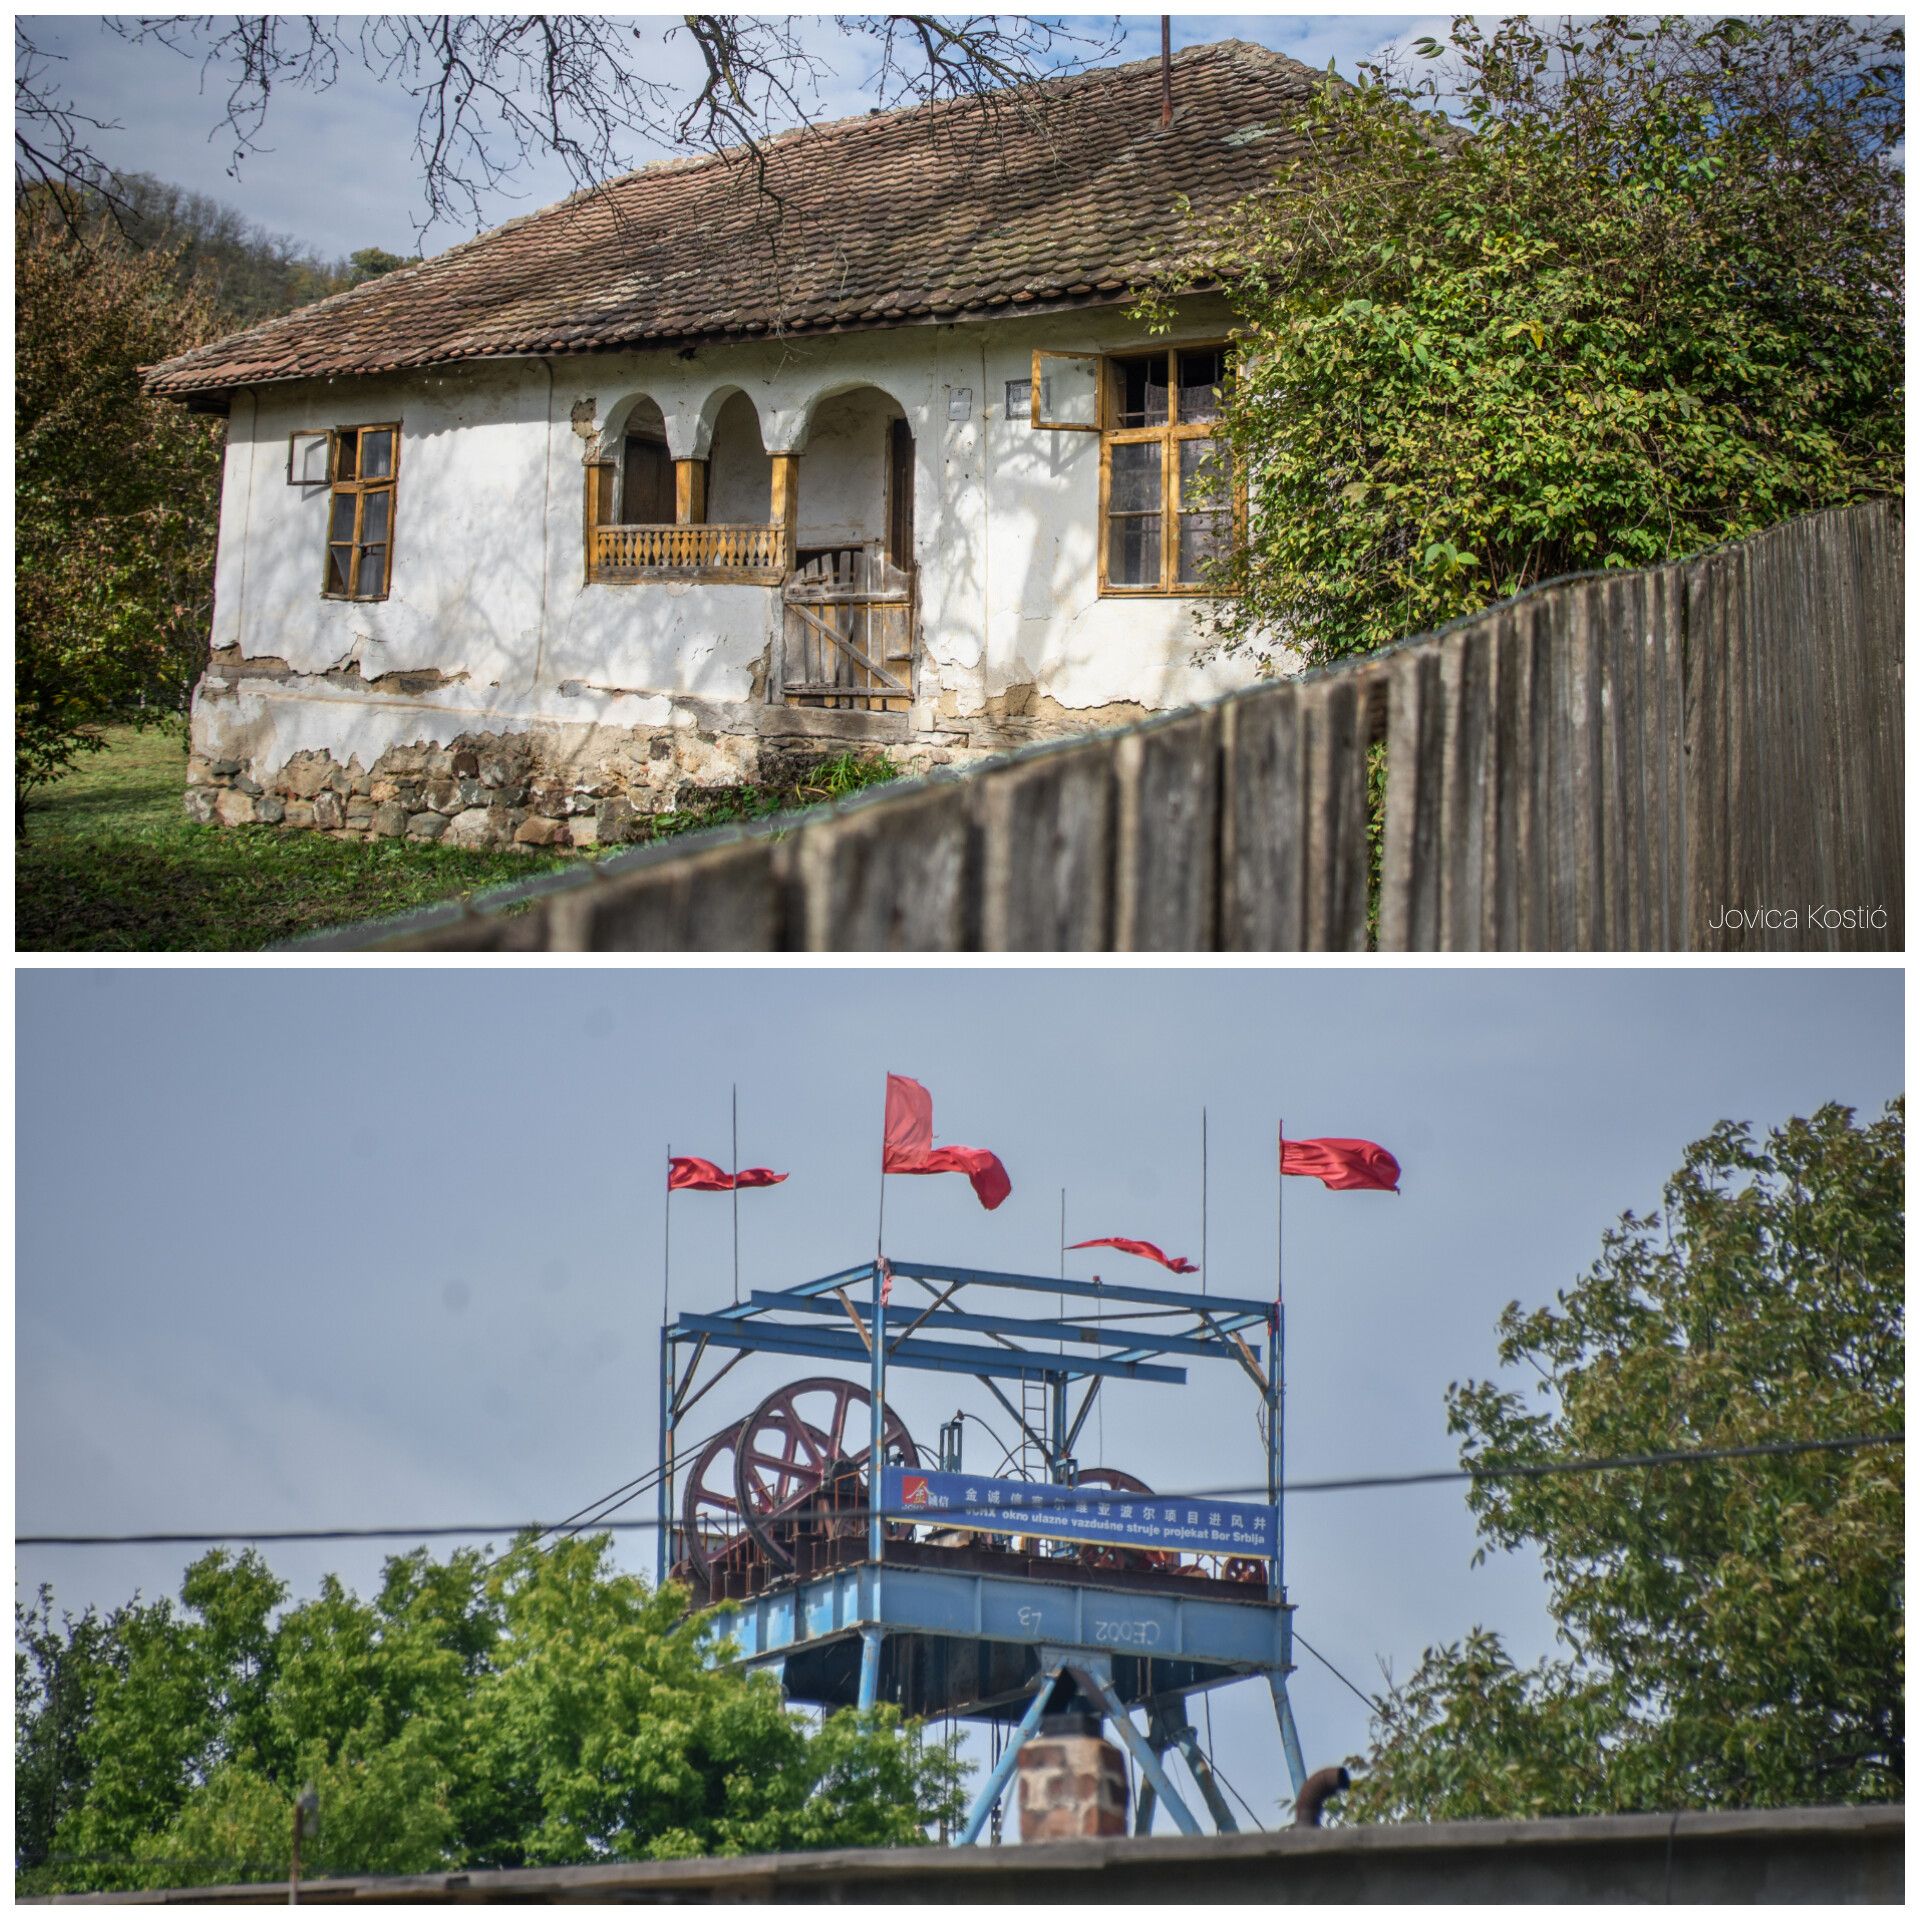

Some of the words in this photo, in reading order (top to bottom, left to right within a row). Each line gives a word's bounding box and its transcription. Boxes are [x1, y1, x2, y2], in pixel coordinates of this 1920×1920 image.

[1002, 1509, 1029, 1521] okno
[1031, 1513, 1069, 1525] ulazne
[1071, 1517, 1124, 1532] vazdušne
[1126, 1522, 1161, 1537] struje
[1163, 1525, 1209, 1539] projekat
[1211, 1529, 1230, 1541] Bor
[1233, 1531, 1265, 1545] Srbija
